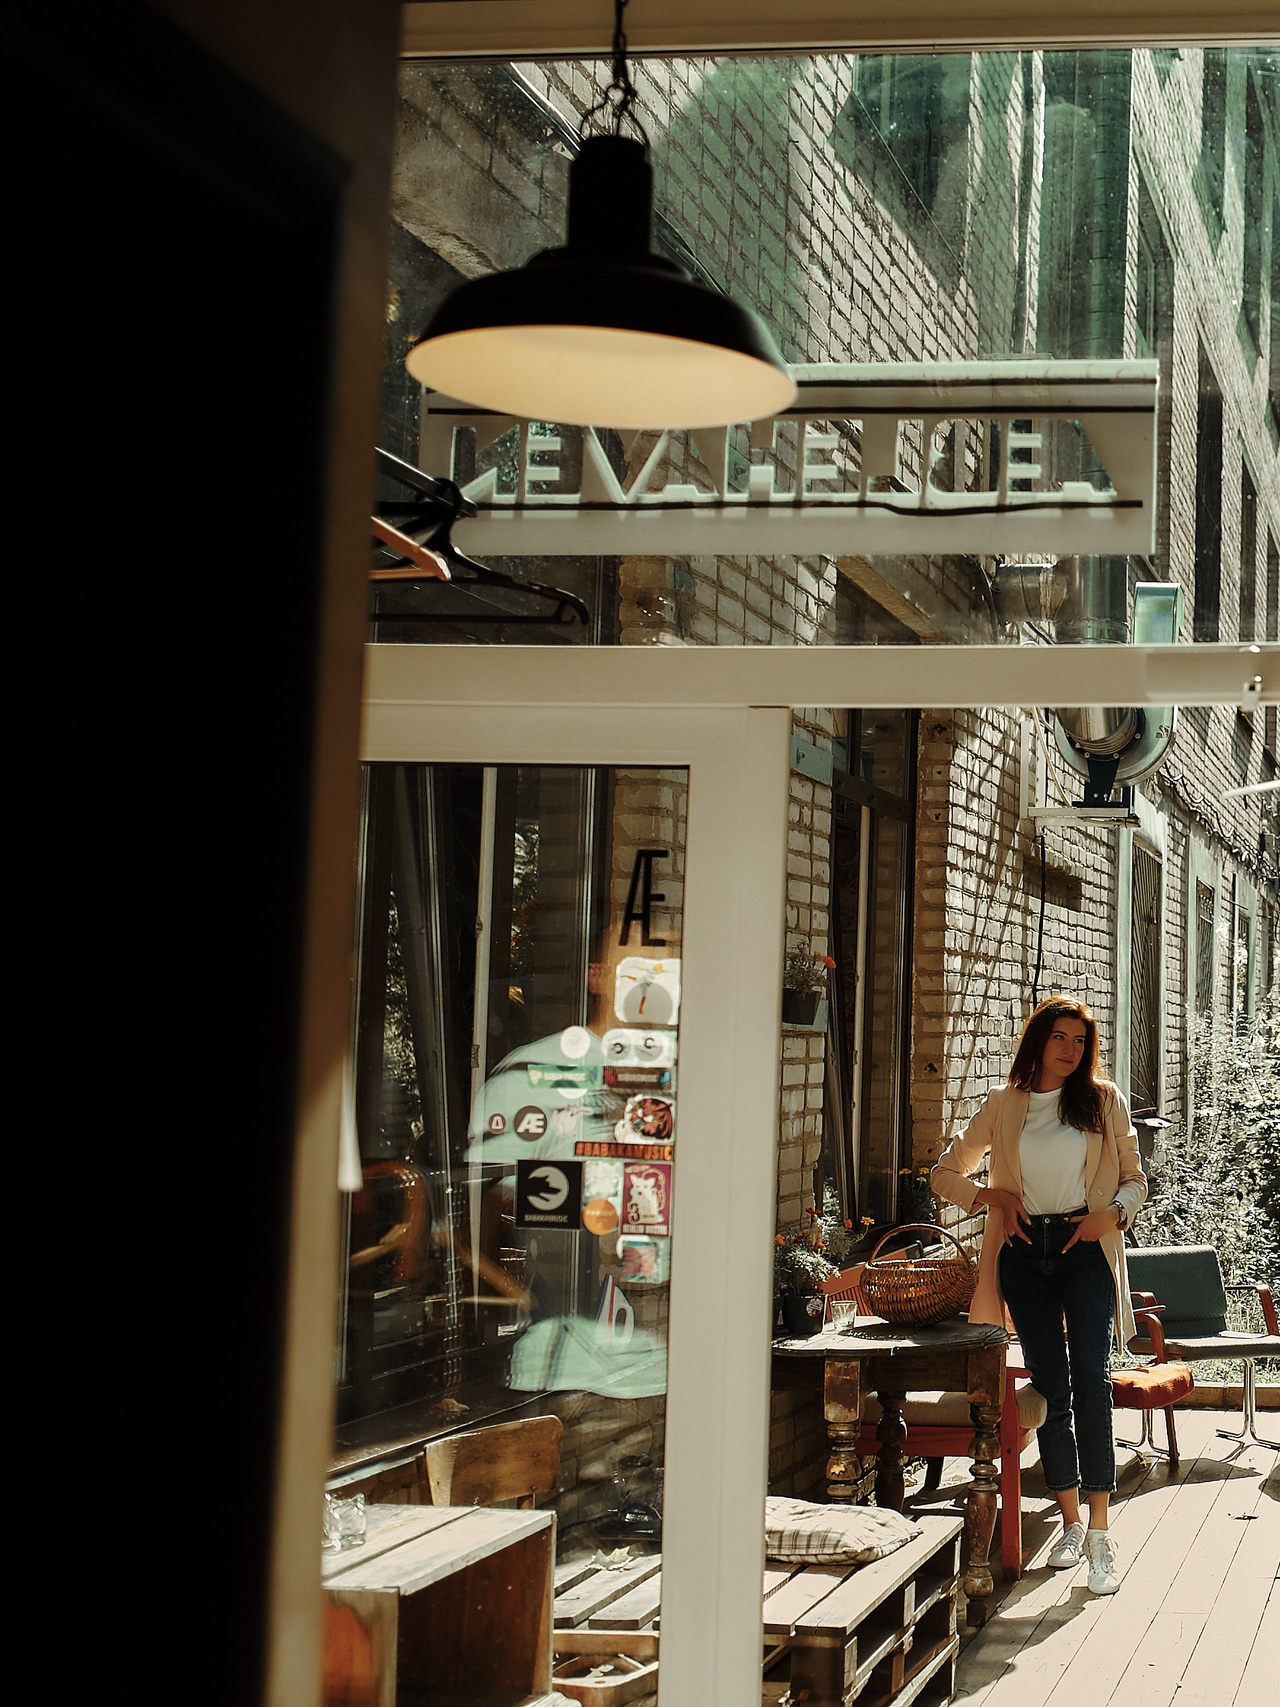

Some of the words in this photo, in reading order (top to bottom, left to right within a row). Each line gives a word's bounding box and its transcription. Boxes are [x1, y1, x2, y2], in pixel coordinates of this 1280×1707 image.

[619, 849, 669, 946] Æ
[516, 1113, 545, 1134] Æ
[575, 1142, 673, 1161] #BABAKAMUSIC
